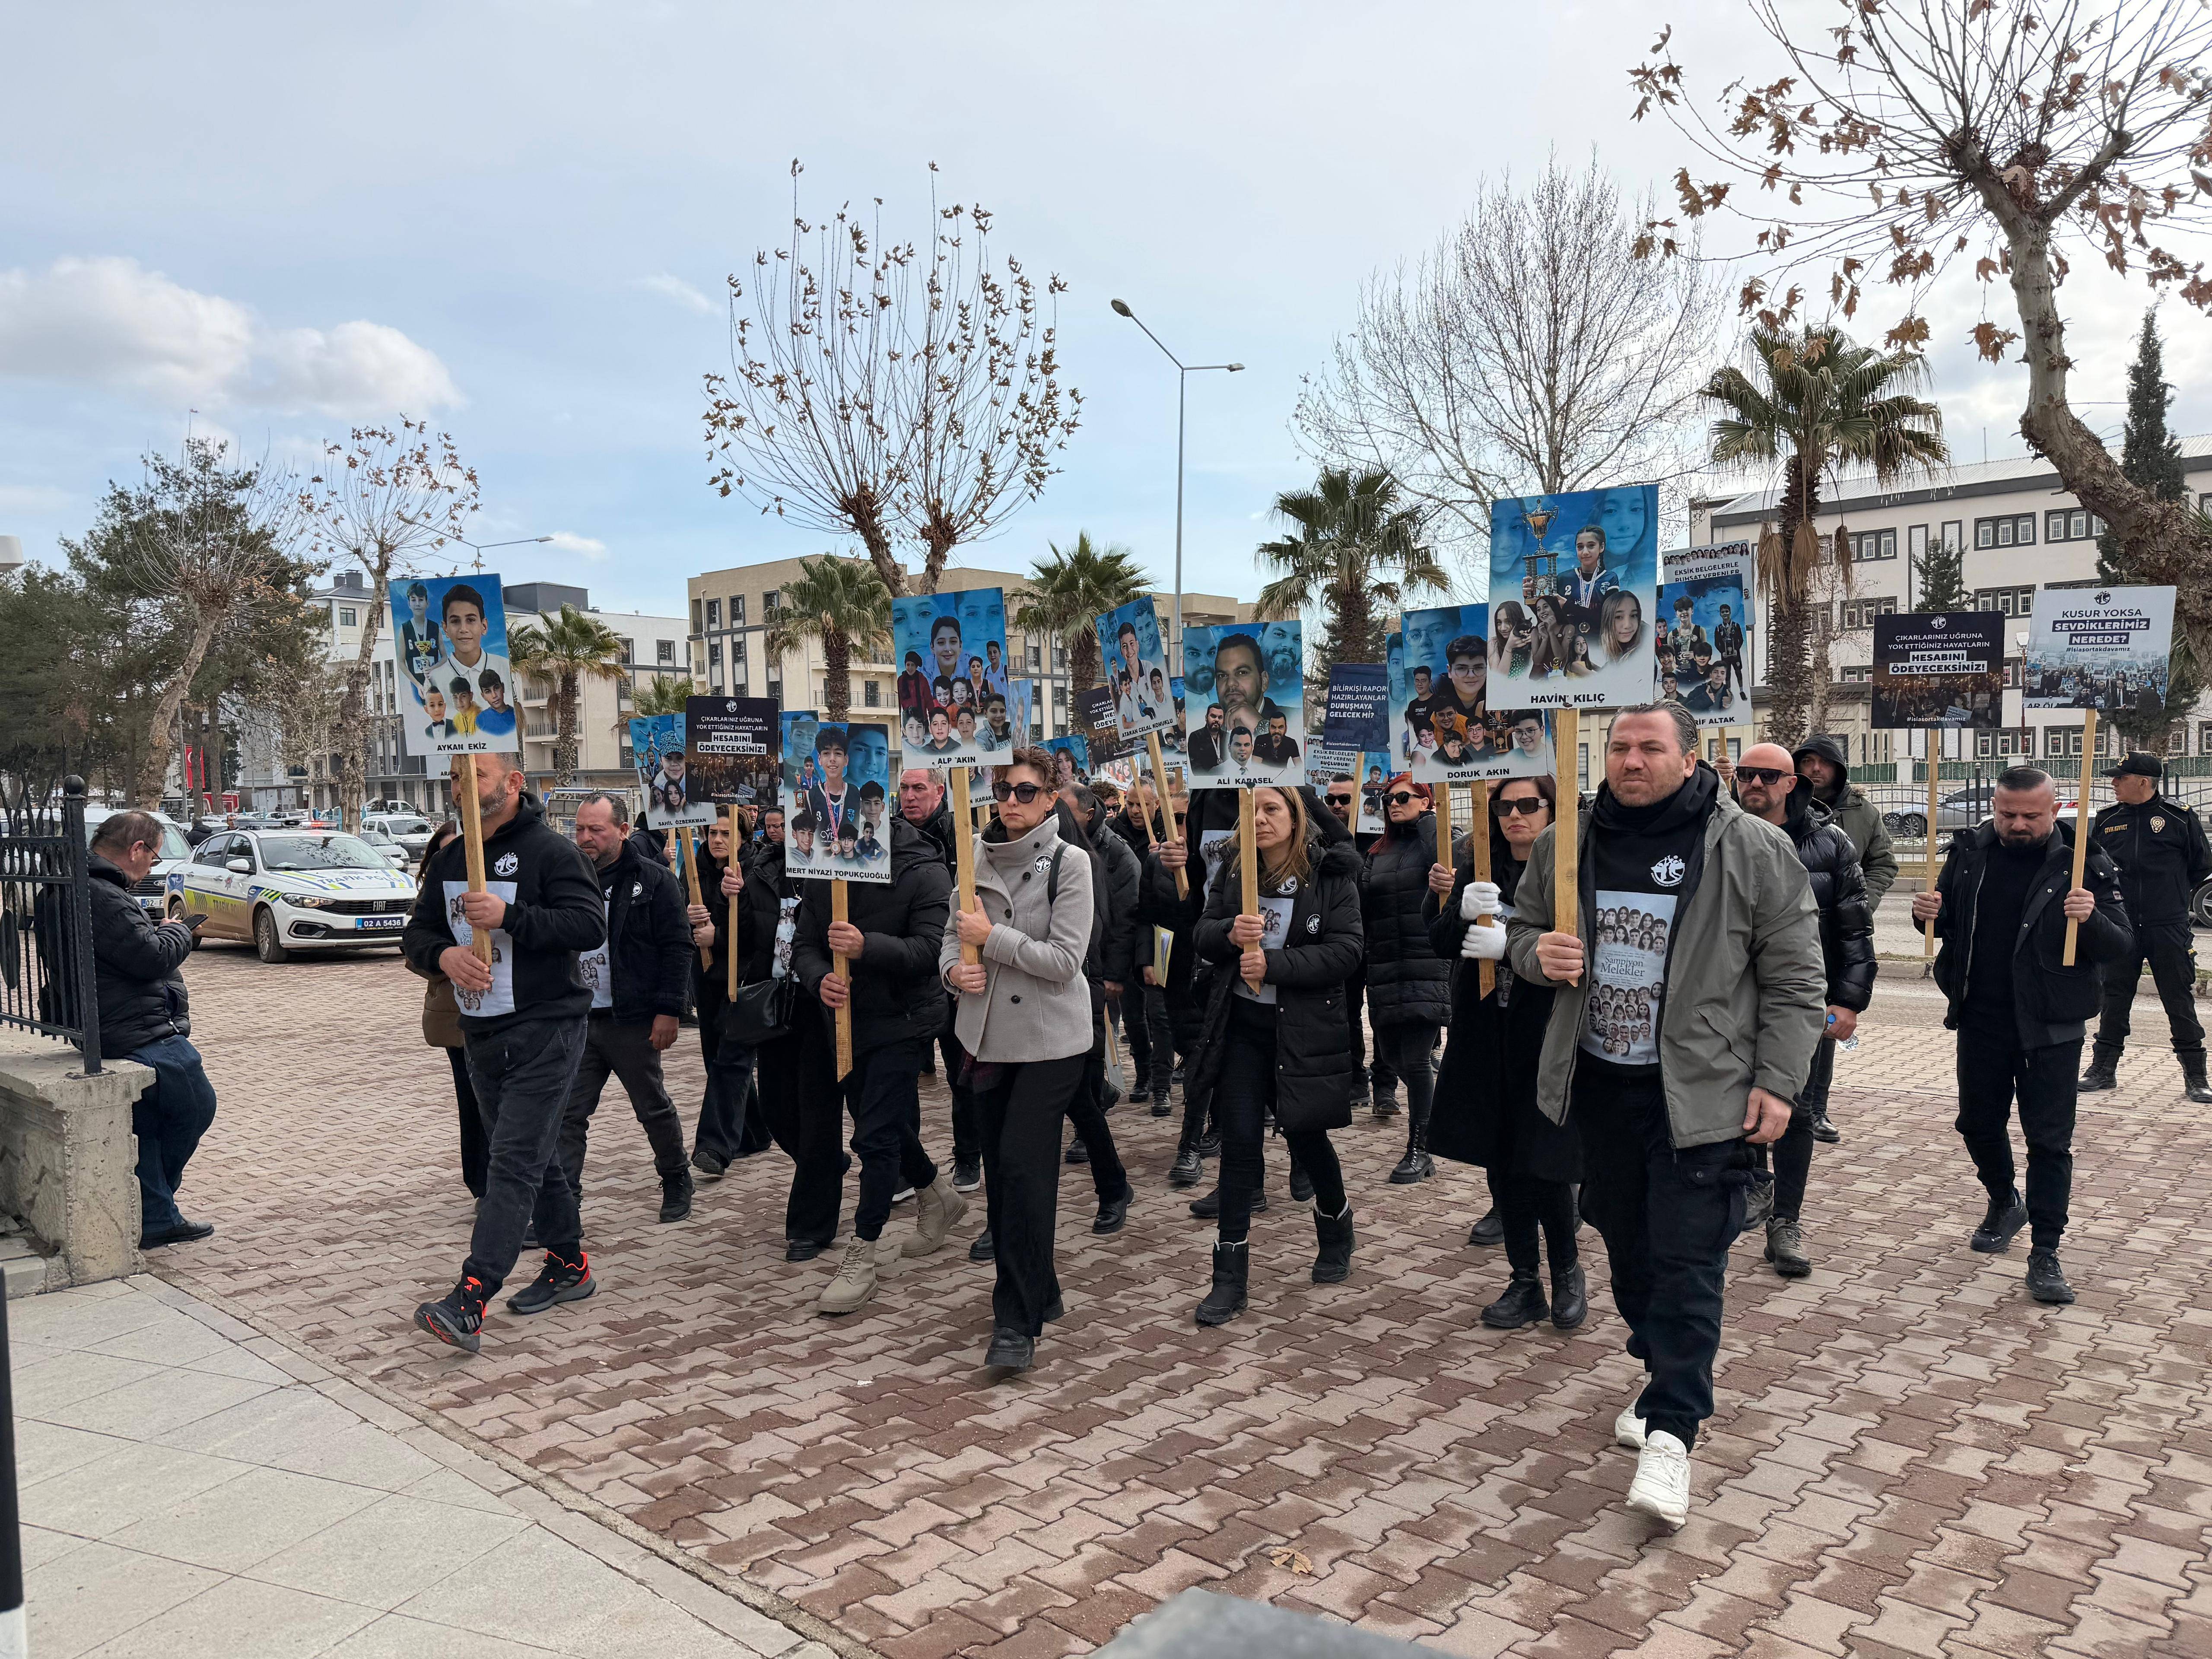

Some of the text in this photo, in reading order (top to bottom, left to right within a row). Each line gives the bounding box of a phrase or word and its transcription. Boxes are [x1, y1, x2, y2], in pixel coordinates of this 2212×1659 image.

[1675, 562, 1738, 575] EKSİK BELGELERLE
[1565, 585, 1572, 596] 2
[2055, 619, 2147, 631] SEVDİKLERİMİZ
[1895, 634, 1948, 642] ÇIKARLARINIZ
[2072, 635, 2126, 644] NEREDE?
[408, 639, 413, 650] 6
[1912, 653, 1964, 661] HESABINI
[1891, 662, 1985, 673] ÖDEYECEKSİNİZ!
[1332, 684, 1361, 693] BİLİRKİŞİ
[1531, 693, 1605, 703] HAVİN KILIÇ
[1096, 718, 1116, 728] ÖDEYE
[1122, 728, 1138, 737] ATAKAN
[1152, 718, 1173, 728] KONUKLU
[437, 741, 486, 751] AYKAN EKİZ
[699, 743, 765, 753] ÖDEYECEKSİNİZ!
[1448, 770, 1480, 778] DORUK
[816, 811, 822, 821] 3
[809, 868, 832, 876] NİYAZİ
[834, 871, 890, 879] TOPUKÇUOĞLU
[373, 901, 386, 911] FIAT
[1605, 955, 1643, 968] Şampiyon
[1600, 963, 1645, 976] Melekler
